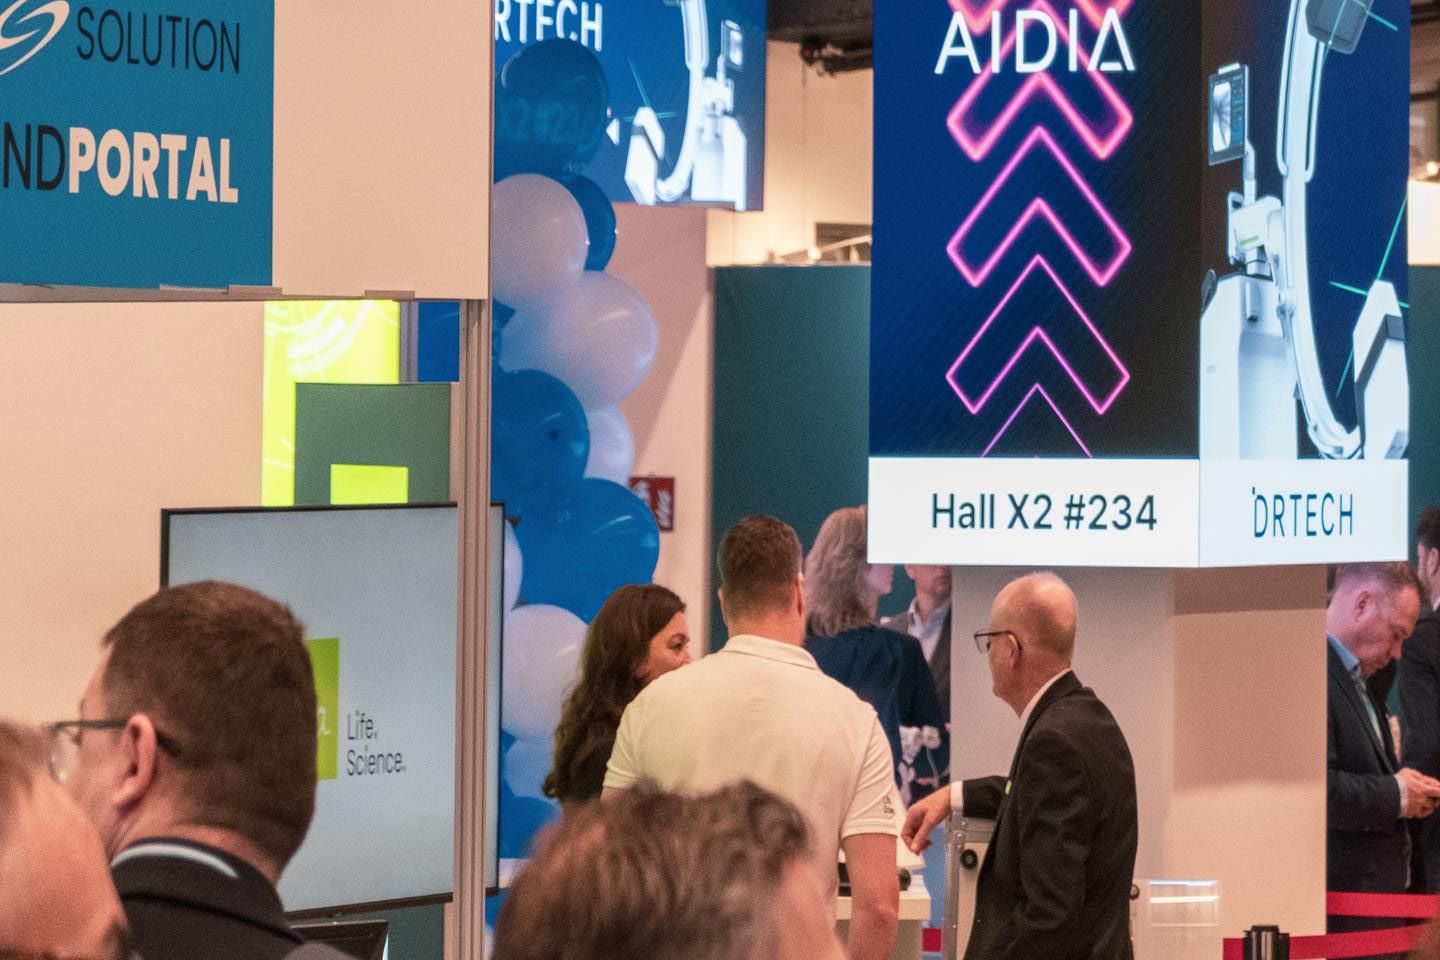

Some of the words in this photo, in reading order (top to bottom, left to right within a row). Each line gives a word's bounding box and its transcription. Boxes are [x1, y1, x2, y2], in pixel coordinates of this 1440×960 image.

[76, 6, 240, 74] SOLUTION
[934, 7, 1136, 74] AIDIA
[931, 493, 996, 530] Hall
[1007, 493, 1052, 530] X2
[1063, 493, 1157, 531] #234
[1252, 486, 1353, 538] DRTECH
